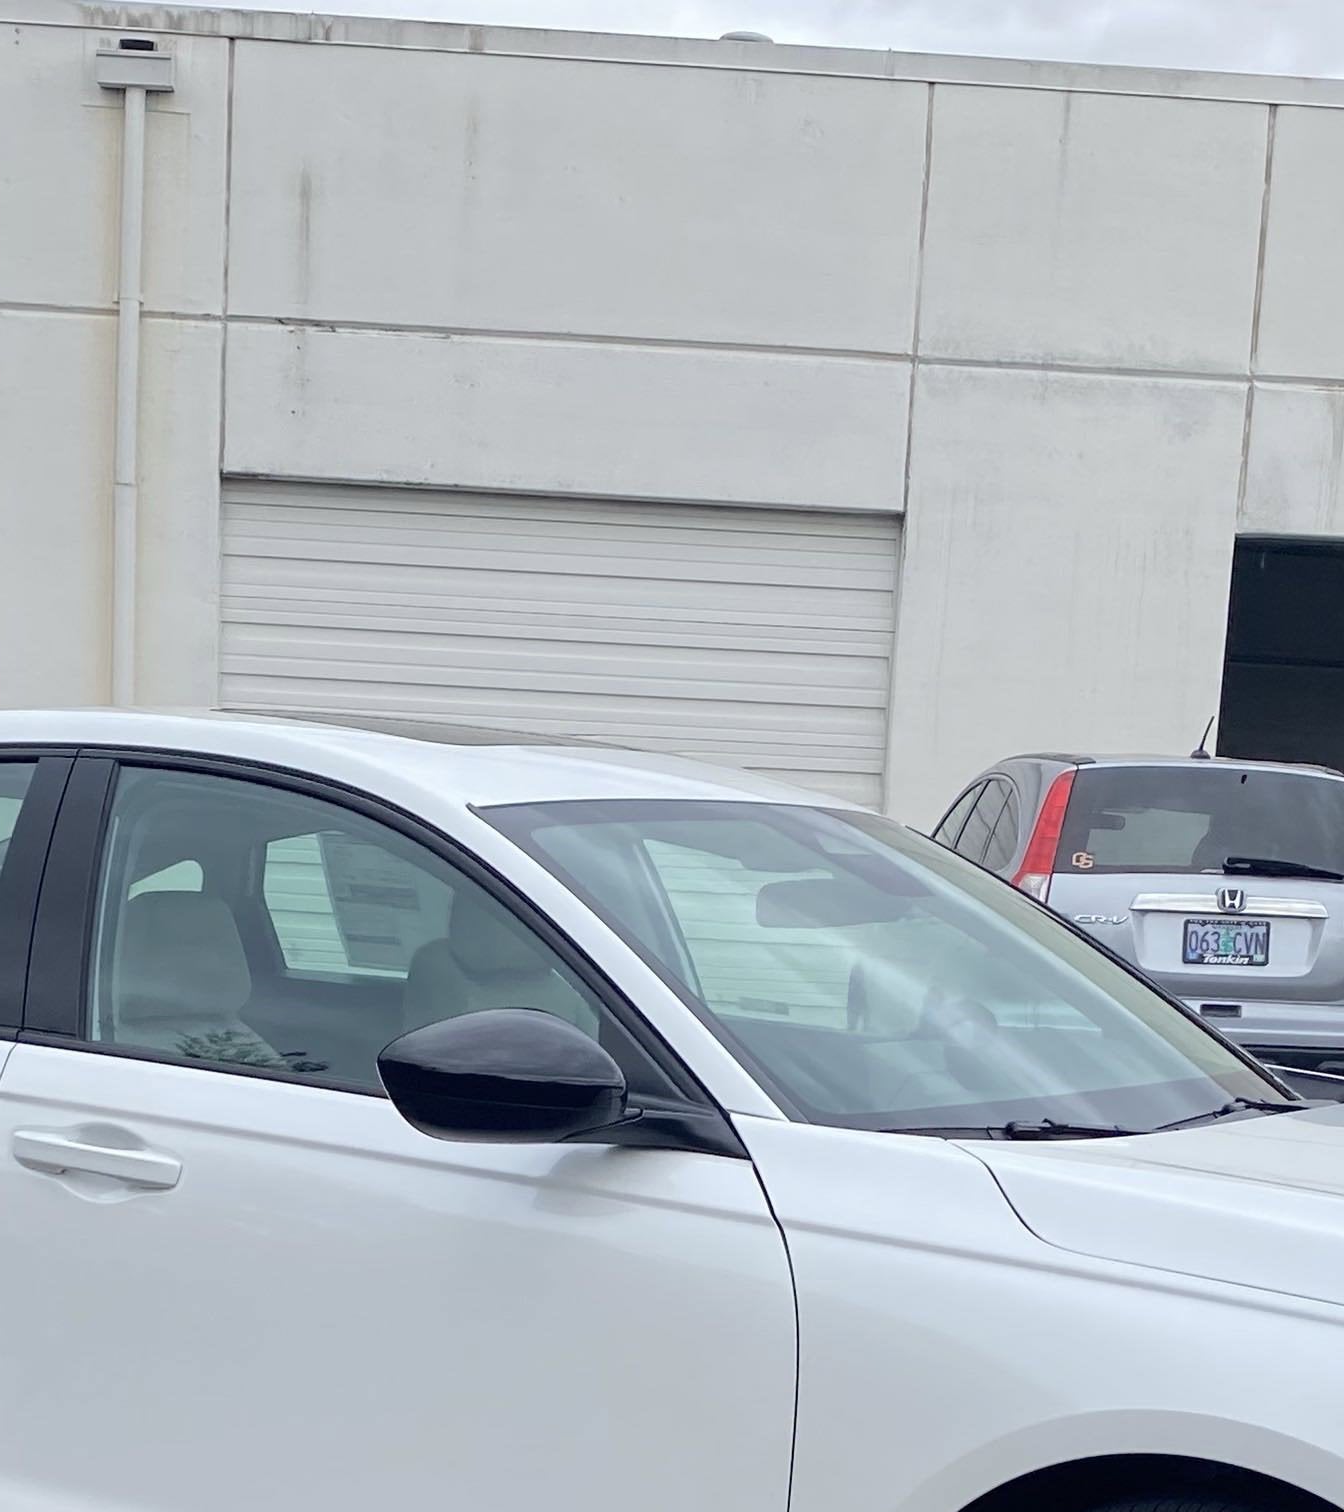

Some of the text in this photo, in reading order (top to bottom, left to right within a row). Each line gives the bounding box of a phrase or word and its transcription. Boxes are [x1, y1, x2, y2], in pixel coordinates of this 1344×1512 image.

[1074, 914, 1129, 925] CR-V
[1189, 930, 1266, 955] 063 CVN
[1202, 953, 1250, 965] Tonkin
